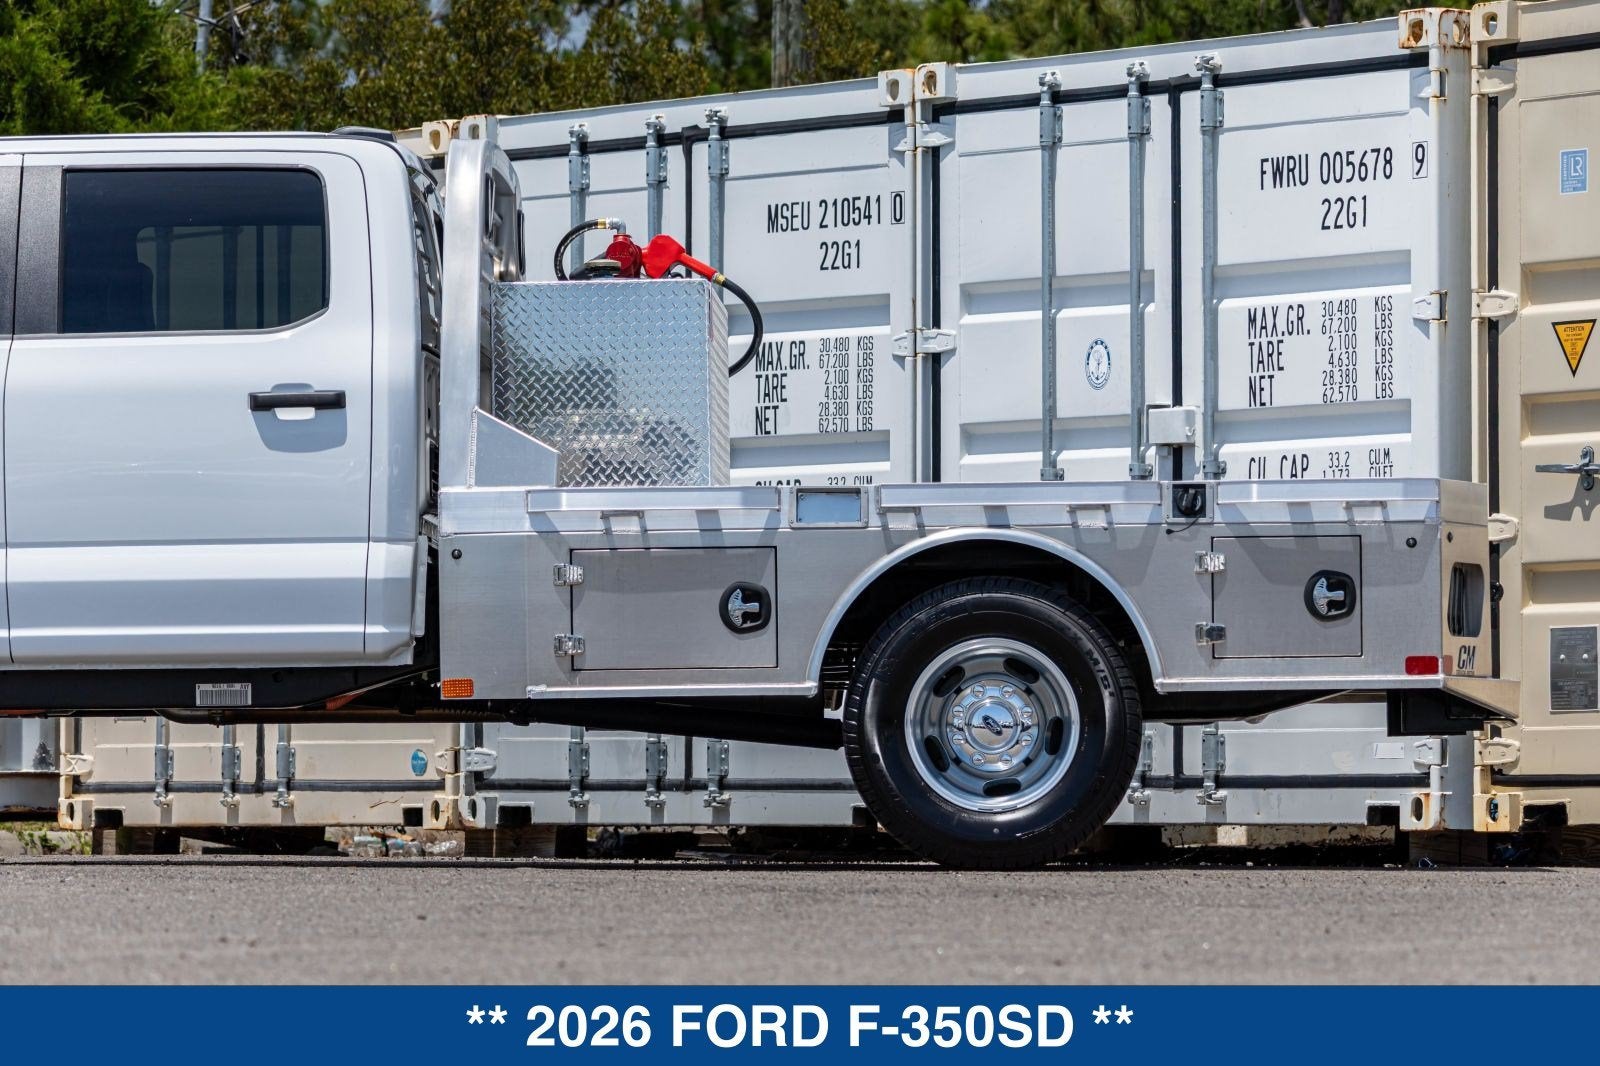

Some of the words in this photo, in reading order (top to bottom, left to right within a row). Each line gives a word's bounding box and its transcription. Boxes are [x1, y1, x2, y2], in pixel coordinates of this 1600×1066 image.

[1260, 153, 1309, 190] FWRU
[1319, 146, 1393, 185] 005678
[1414, 143, 1426, 176] 9
[767, 201, 811, 233] MSEU
[819, 195, 881, 229] 210541
[893, 193, 903, 222] 0
[1321, 195, 1367, 230] 22G1
[819, 239, 861, 271] 22G1
[1247, 303, 1311, 340] MAX.GR.
[1374, 295, 1393, 313] KGS
[1374, 312, 1393, 330] LBS
[755, 340, 810, 372] MAX.GR.
[857, 335, 874, 352] KGS
[857, 351, 874, 368] LBS
[1248, 339, 1284, 373] TARE
[1374, 329, 1393, 347] KGS
[1374, 347, 1393, 365] LBS
[755, 372, 788, 404] TARE
[856, 367, 874, 384] KGS
[856, 383, 873, 400] LBS
[1248, 374, 1275, 408] NET
[1374, 364, 1393, 382] KGS
[1375, 381, 1394, 399] LBS
[755, 404, 779, 436] NET
[856, 399, 873, 417] KGS
[856, 416, 873, 433] LBS
[1457, 644, 1476, 670] CM
